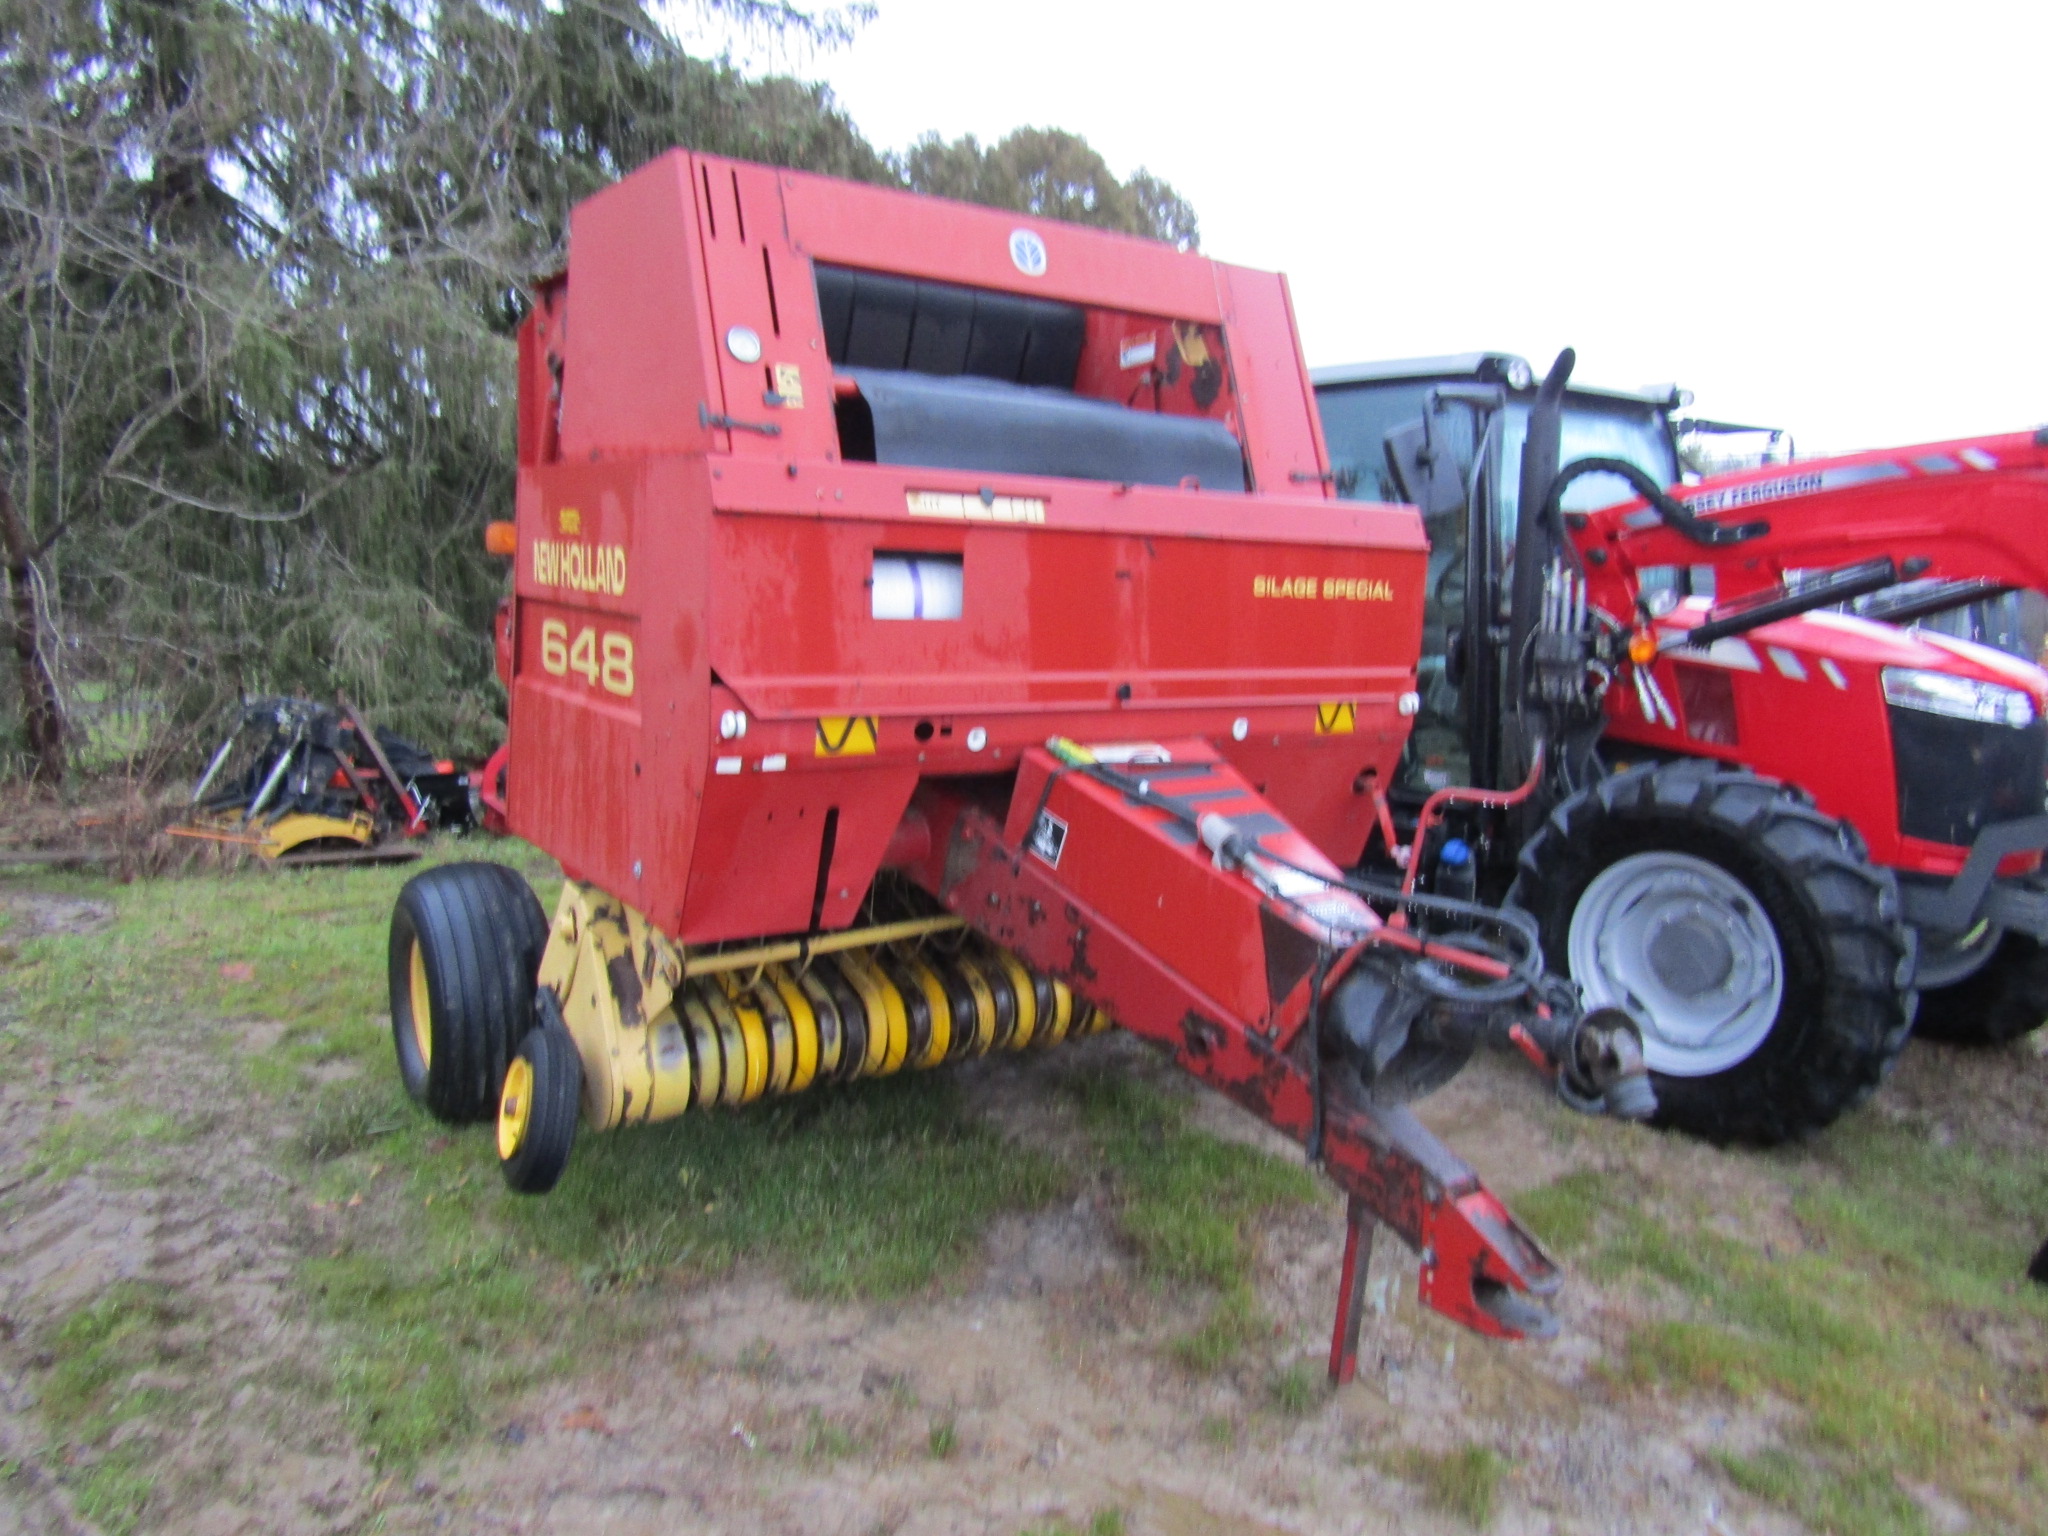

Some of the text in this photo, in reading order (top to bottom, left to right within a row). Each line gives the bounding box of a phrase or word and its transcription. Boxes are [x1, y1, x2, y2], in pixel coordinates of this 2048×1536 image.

[1730, 474, 1823, 506] FERGUSON
[534, 539, 626, 597] NEW HOLLAND
[1253, 574, 1393, 601] SILAGE SPECIAL
[541, 617, 634, 697] 648
